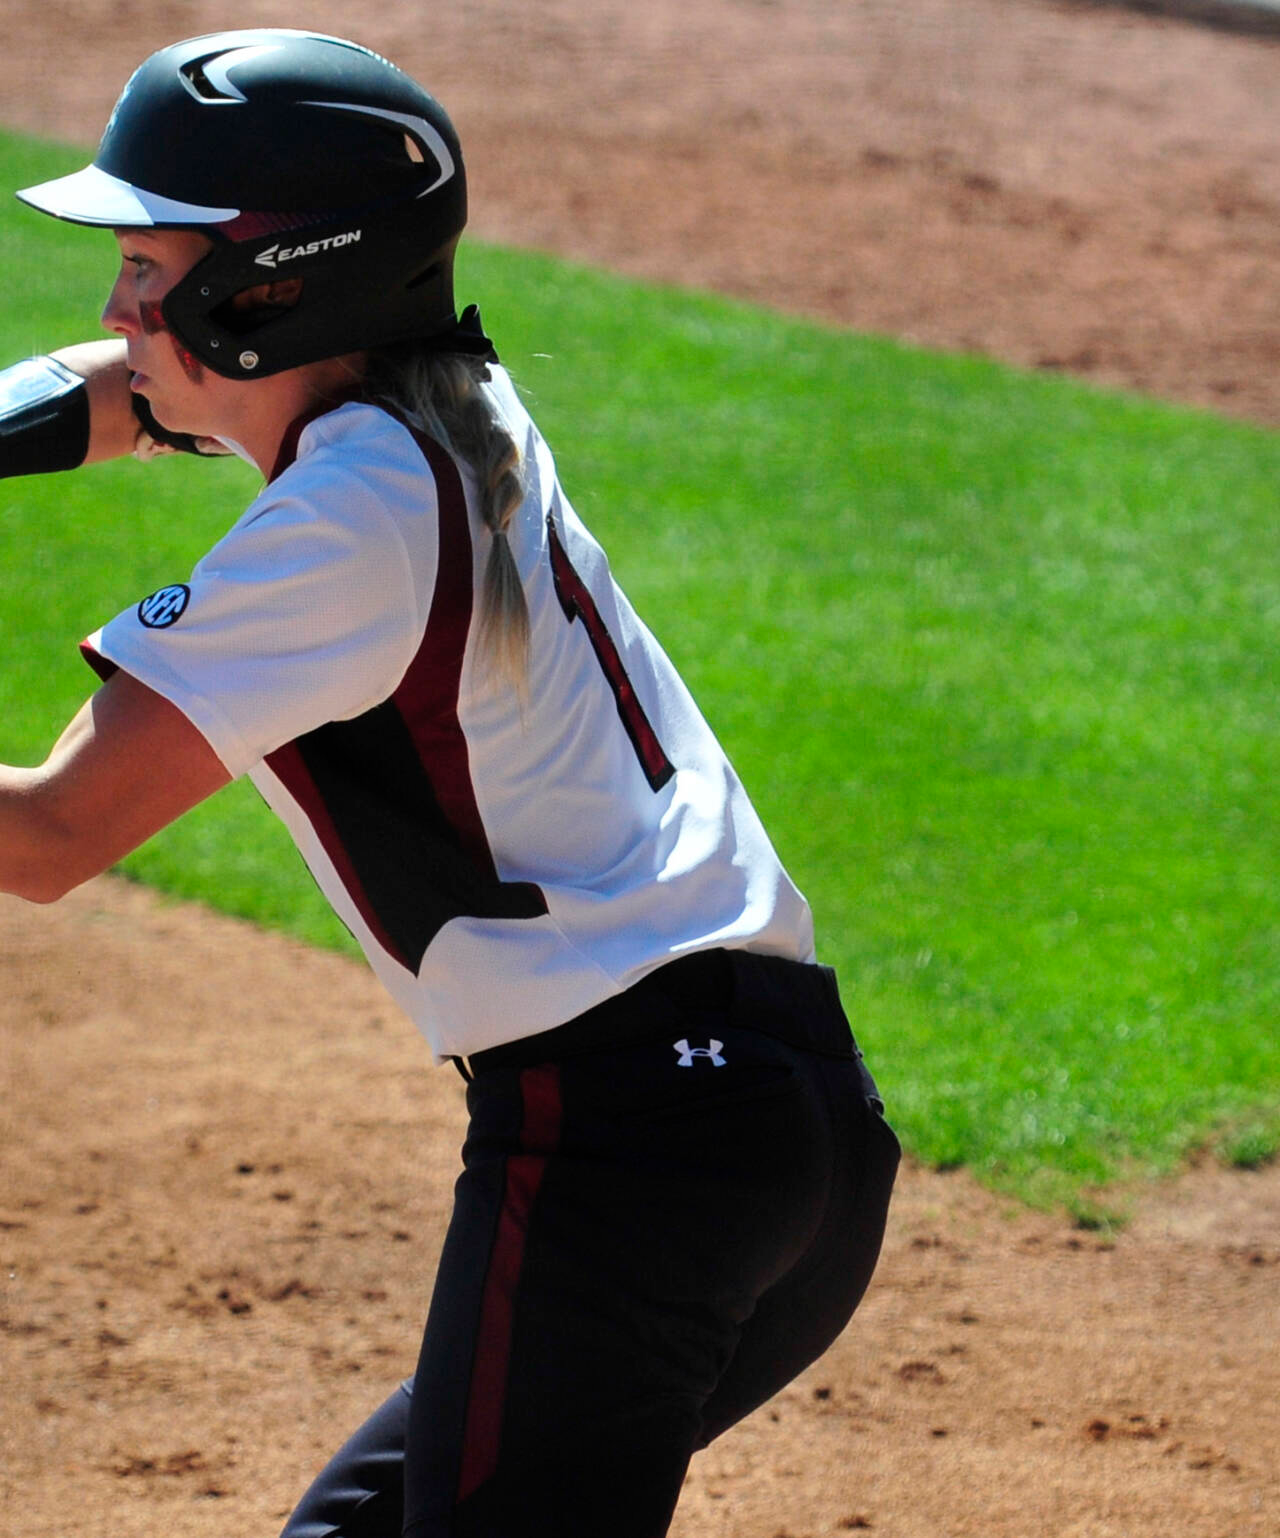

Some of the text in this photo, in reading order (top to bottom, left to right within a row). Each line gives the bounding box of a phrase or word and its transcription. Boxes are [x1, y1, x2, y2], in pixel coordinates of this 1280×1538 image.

[277, 230, 361, 261] EASTON
[140, 586, 187, 625] SEC
[546, 508, 677, 793] 1
